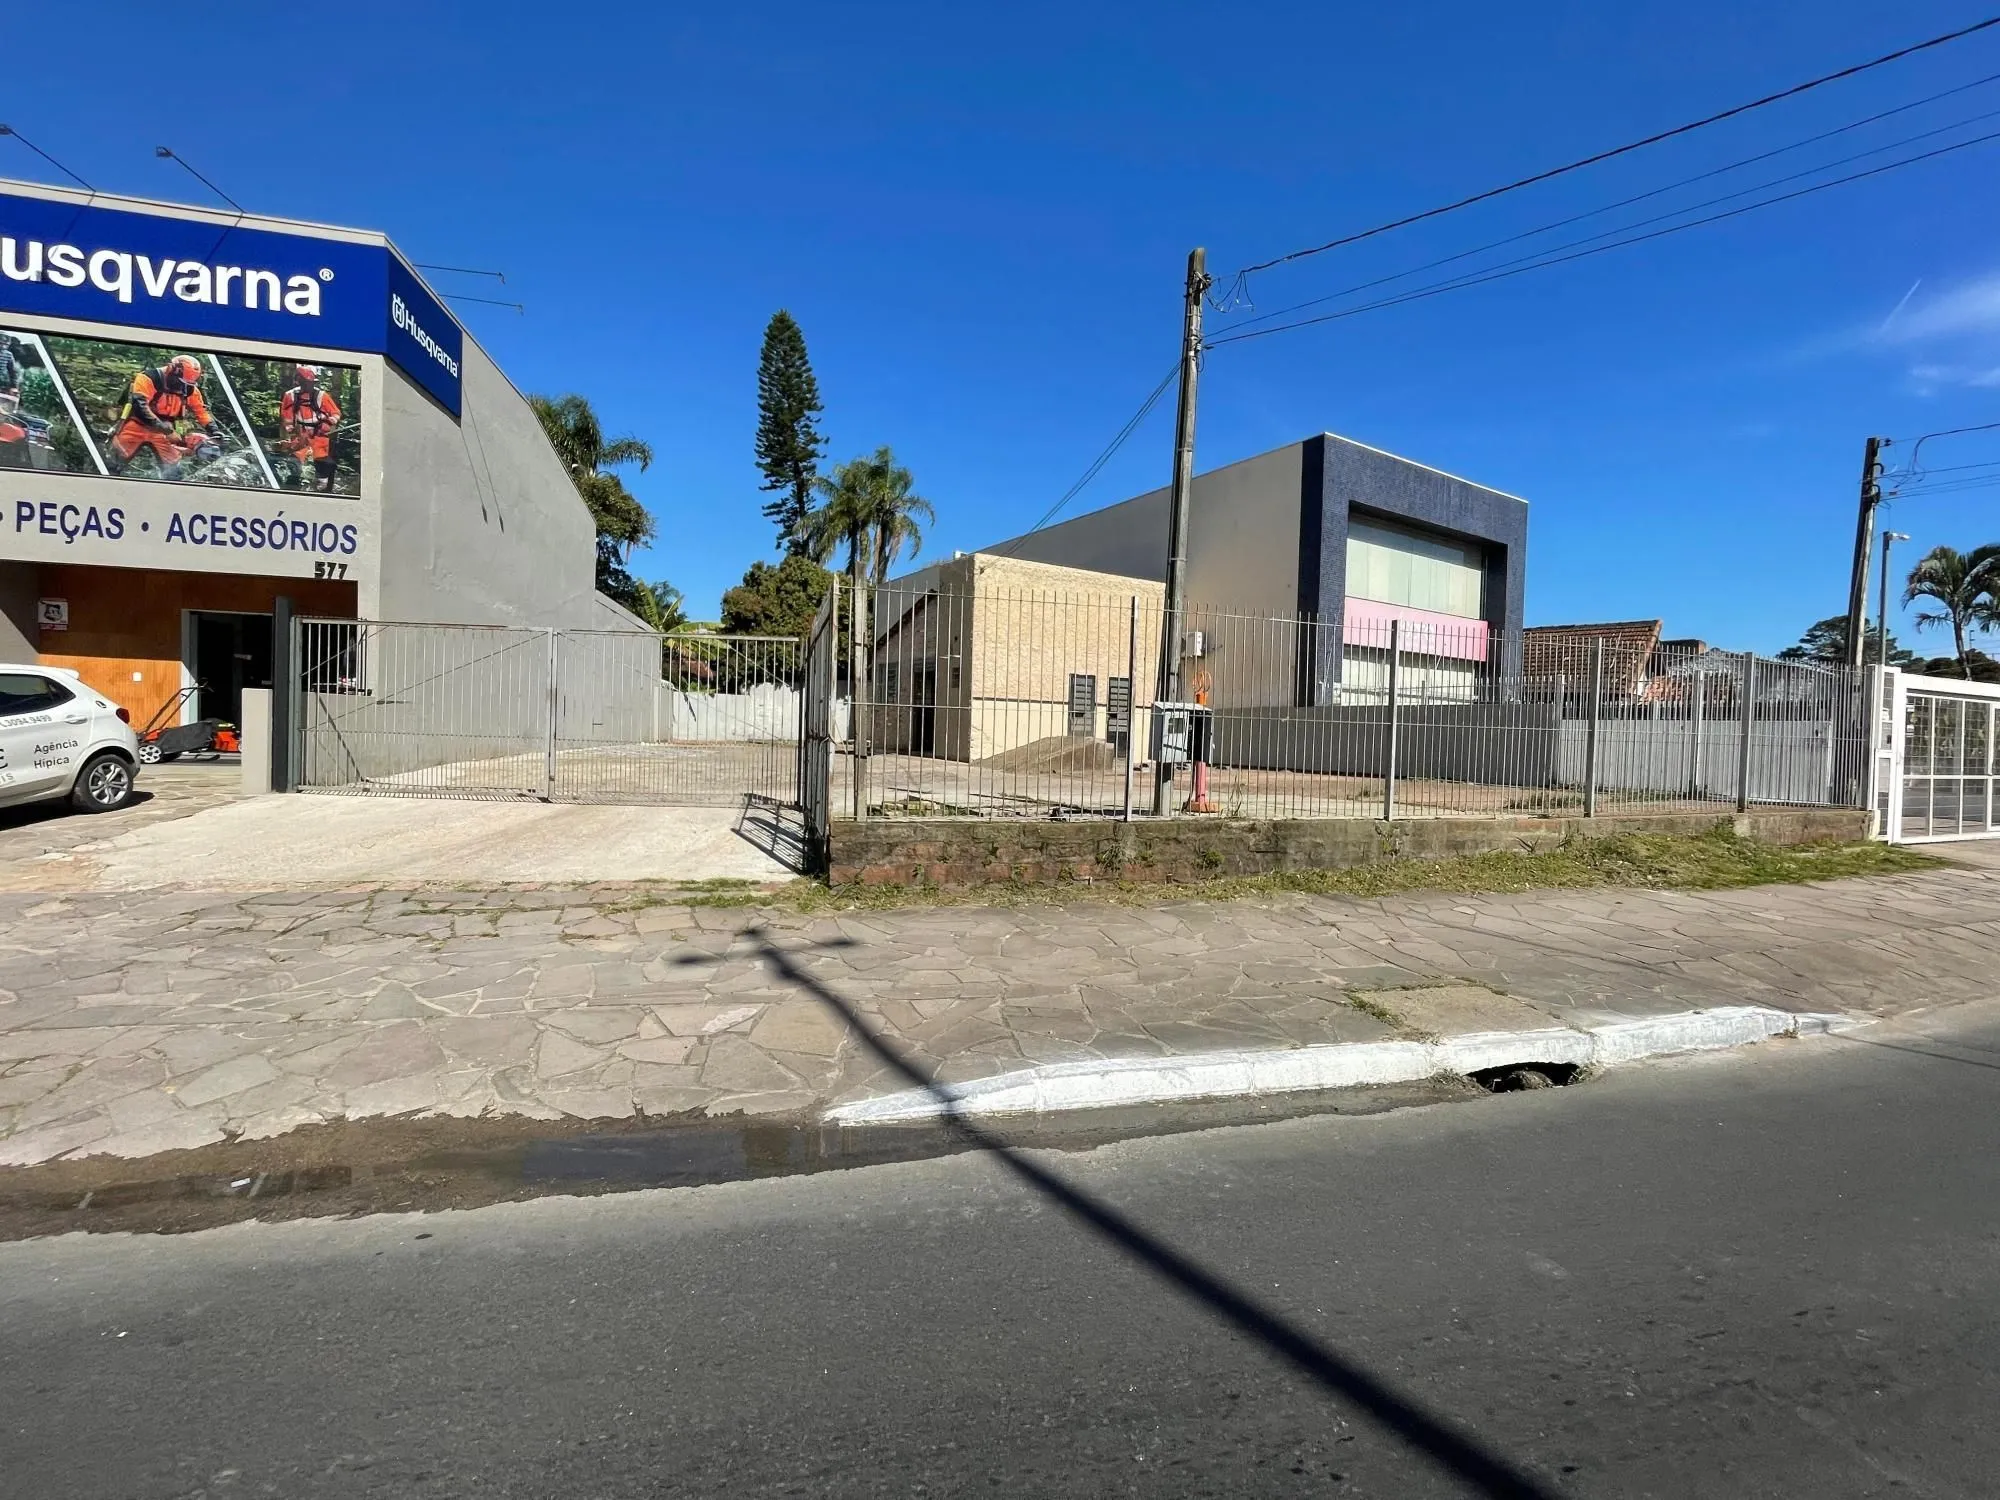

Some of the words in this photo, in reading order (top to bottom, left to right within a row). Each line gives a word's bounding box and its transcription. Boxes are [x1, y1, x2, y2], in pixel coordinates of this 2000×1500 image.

[405, 309, 458, 379] Husqvarna
[15, 500, 125, 544] PEÇAS
[165, 511, 358, 555] ACESSÓRIOS
[314, 561, 348, 580] 577
[34, 739, 78, 754] Agência
[34, 756, 70, 769] Hípica
